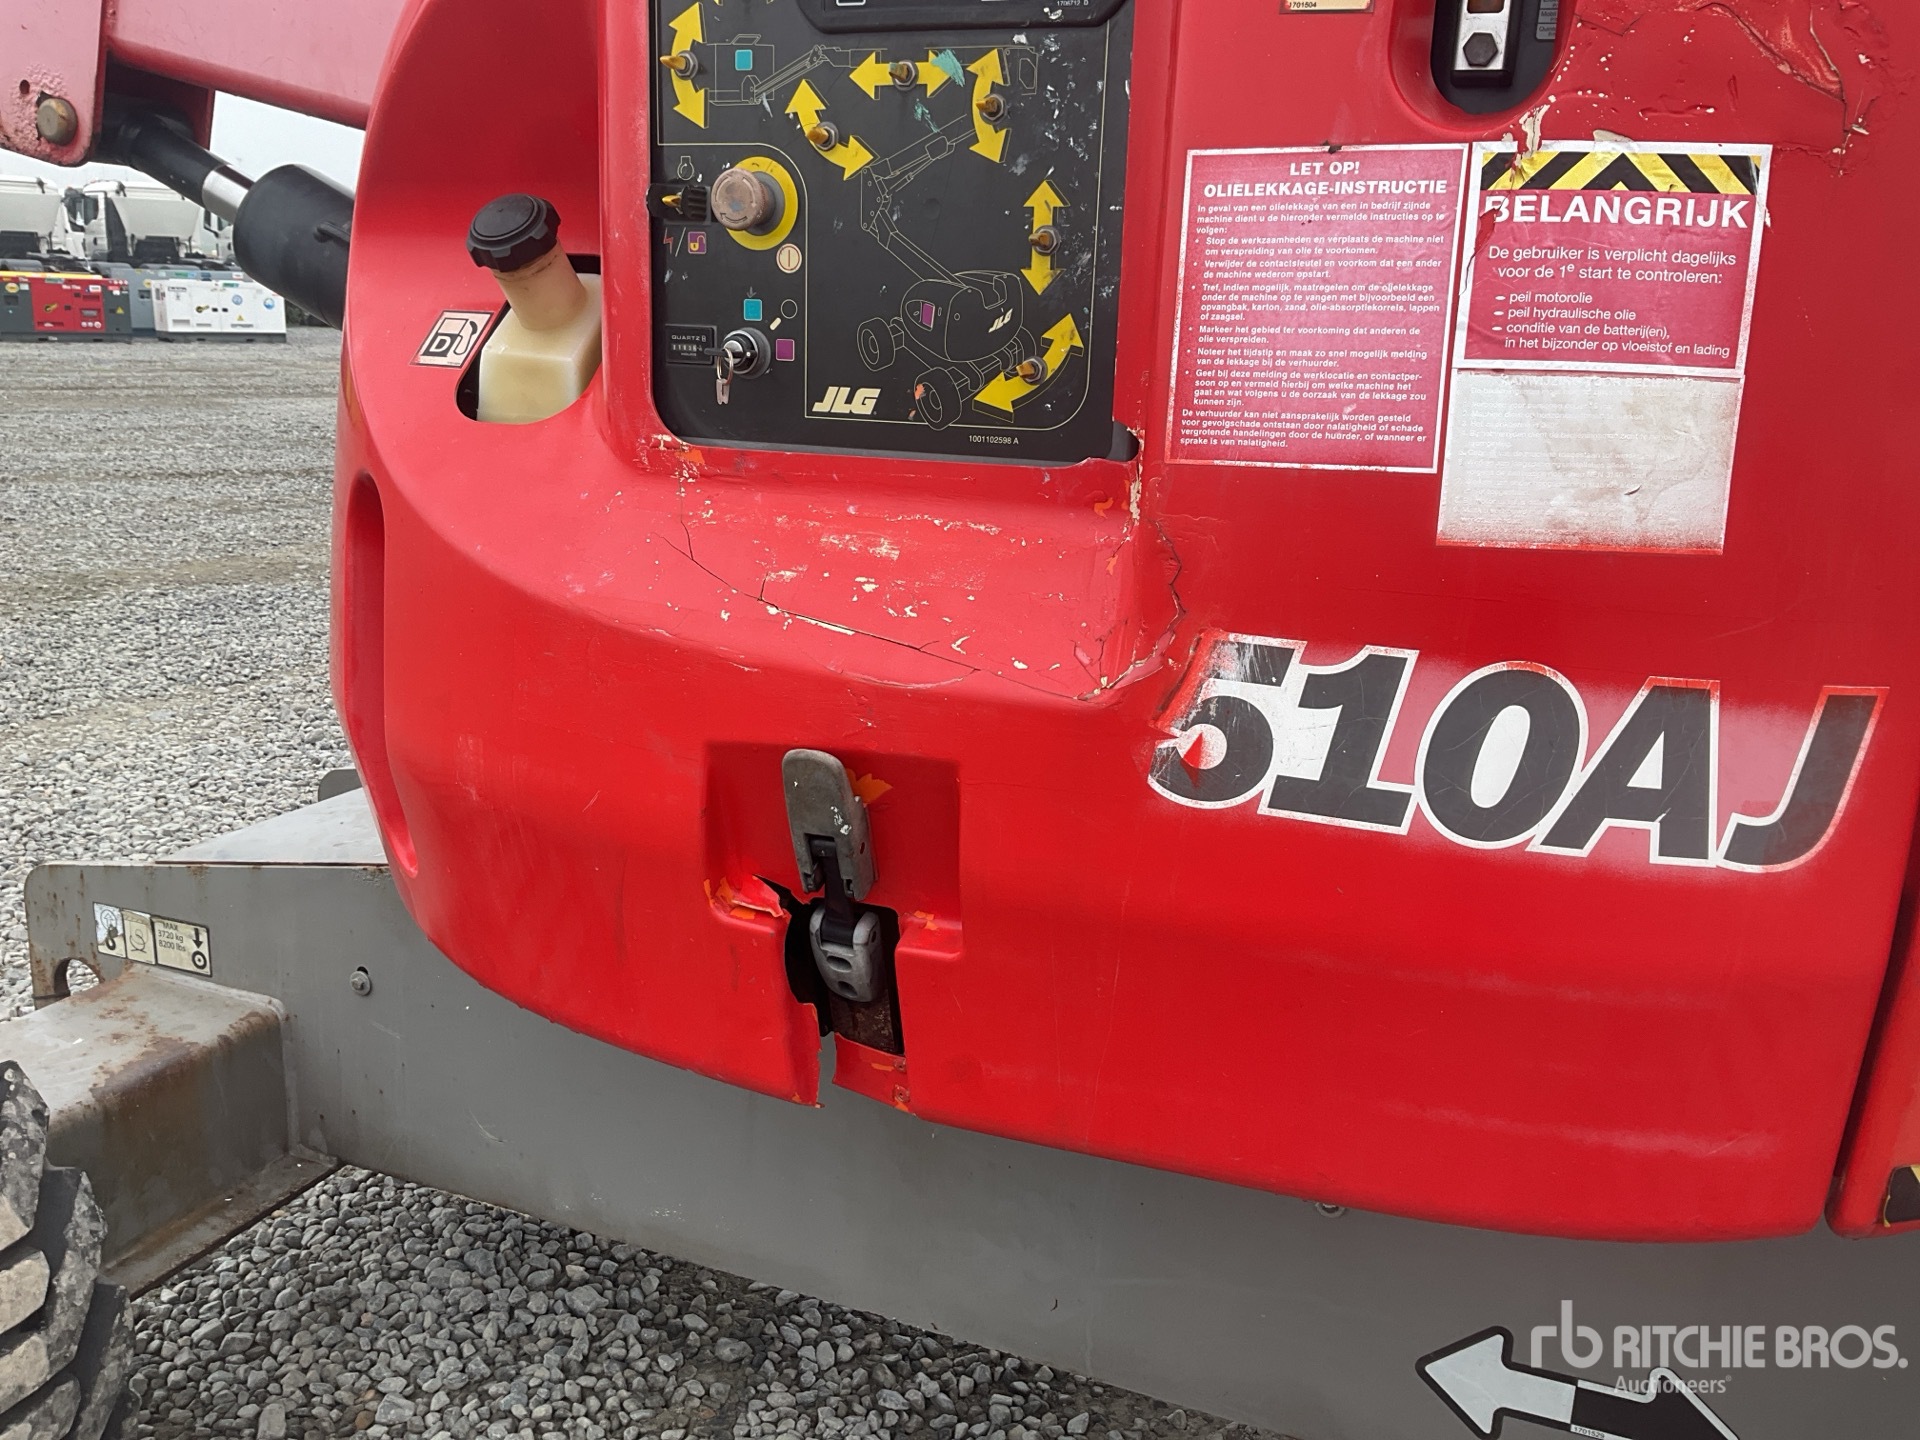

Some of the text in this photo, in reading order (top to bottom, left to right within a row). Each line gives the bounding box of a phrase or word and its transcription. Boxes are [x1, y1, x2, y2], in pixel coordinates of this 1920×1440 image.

[1290, 161, 1360, 176] LET OP!
[1204, 180, 1448, 197] OLIELEKKAGE-INSTRUCTIE
[1208, 204, 1230, 214] geval
[1233, 204, 1248, 212] van
[1270, 202, 1319, 213] olielekkage
[1322, 203, 1338, 211] van
[1341, 202, 1356, 211] een
[1360, 202, 1368, 210] in
[1371, 201, 1401, 211] bedrijf
[1403, 201, 1430, 211] zijnde
[1484, 195, 1750, 228] BELANGRIJK
[1197, 214, 1231, 223] machine
[1234, 214, 1257, 222] dient
[1267, 214, 1278, 222] de
[1280, 213, 1324, 221] hieronder
[1326, 213, 1368, 221] vermelde
[1370, 212, 1418, 221] instructies
[1421, 213, 1433, 222] op
[1196, 226, 1227, 235] volgen:
[1205, 235, 1444, 246] Stop de werkzaamheden en verplaats de machine niet
[1205, 246, 1378, 257] om verspreiding van olie te voorkomen.
[1488, 245, 1737, 267] De gebruiker is verplicht dagelijks
[1204, 260, 1244, 269] Verwijder
[1246, 259, 1257, 267] de
[1260, 259, 1321, 267] contactsleutel
[1337, 259, 1376, 267] voorkom
[1380, 258, 1394, 267] dat
[1396, 259, 1411, 267] een
[1415, 259, 1442, 267] ander
[1216, 270, 1251, 278] machine
[1254, 270, 1293, 278] wederom
[1296, 270, 1331, 279] opstart.
[1498, 266, 1531, 278] voor
[1534, 265, 1554, 278] de
[1578, 266, 1612, 279] start
[1617, 267, 1631, 280] te
[1635, 269, 1722, 284] controleren:
[1203, 283, 1219, 292] Tref,
[1223, 283, 1249, 291] indien
[1252, 283, 1290, 292] mogelijk,
[1294, 284, 1349, 292] maatregelen
[1368, 283, 1379, 291] de
[1509, 291, 1592, 304] peil motorolie
[1200, 303, 1440, 313] opvangbak, karton, zand, olie-absorptiekorrels, lappen
[1507, 306, 1636, 321] peil hydraulische olie
[988, 308, 1013, 333] JLG
[1251, 326, 1281, 335] gebied
[1283, 326, 1295, 334] ter
[1297, 326, 1350, 336] voorkoming
[1352, 326, 1368, 335] dat
[1369, 327, 1406, 335] anderen
[1409, 327, 1420, 335] de
[1506, 322, 1670, 340] conditie van de batterij(en),
[1198, 335, 1269, 344] olie verspreiden.
[1504, 337, 1730, 358] in het bijzonder op vloeistof en lading
[1197, 348, 1225, 356] Noteer
[1227, 348, 1241, 356] het
[1243, 348, 1273, 358] tijdstip
[1289, 349, 1313, 357] maak
[1328, 349, 1347, 357] snel
[1350, 349, 1388, 359] mogelijk
[1390, 350, 1427, 360] melding
[1227, 358, 1259, 367] lekkage
[1262, 358, 1273, 368] bij
[1275, 358, 1286, 366] de
[1289, 359, 1339, 368] verhuurder.
[1196, 369, 1422, 382] Geef bij deze melding de werklocatie en contactper-
[812, 386, 882, 415] JLG
[1182, 408, 1193, 416] De
[1195, 409, 1242, 418] verhuurder
[1244, 410, 1259, 418] kan
[1262, 410, 1278, 419] niet
[1280, 411, 1339, 422] aansprakelijk
[1378, 414, 1411, 423] gesteld
[969, 435, 1019, 445] 1001102598 A
[1148, 630, 1890, 874] 510AJ
[162, 922, 178, 931] MAX
[158, 930, 184, 943] 3720 kg
[159, 940, 186, 952] 8200 lbs
[1572, 1426, 1605, 1438] 1701529
